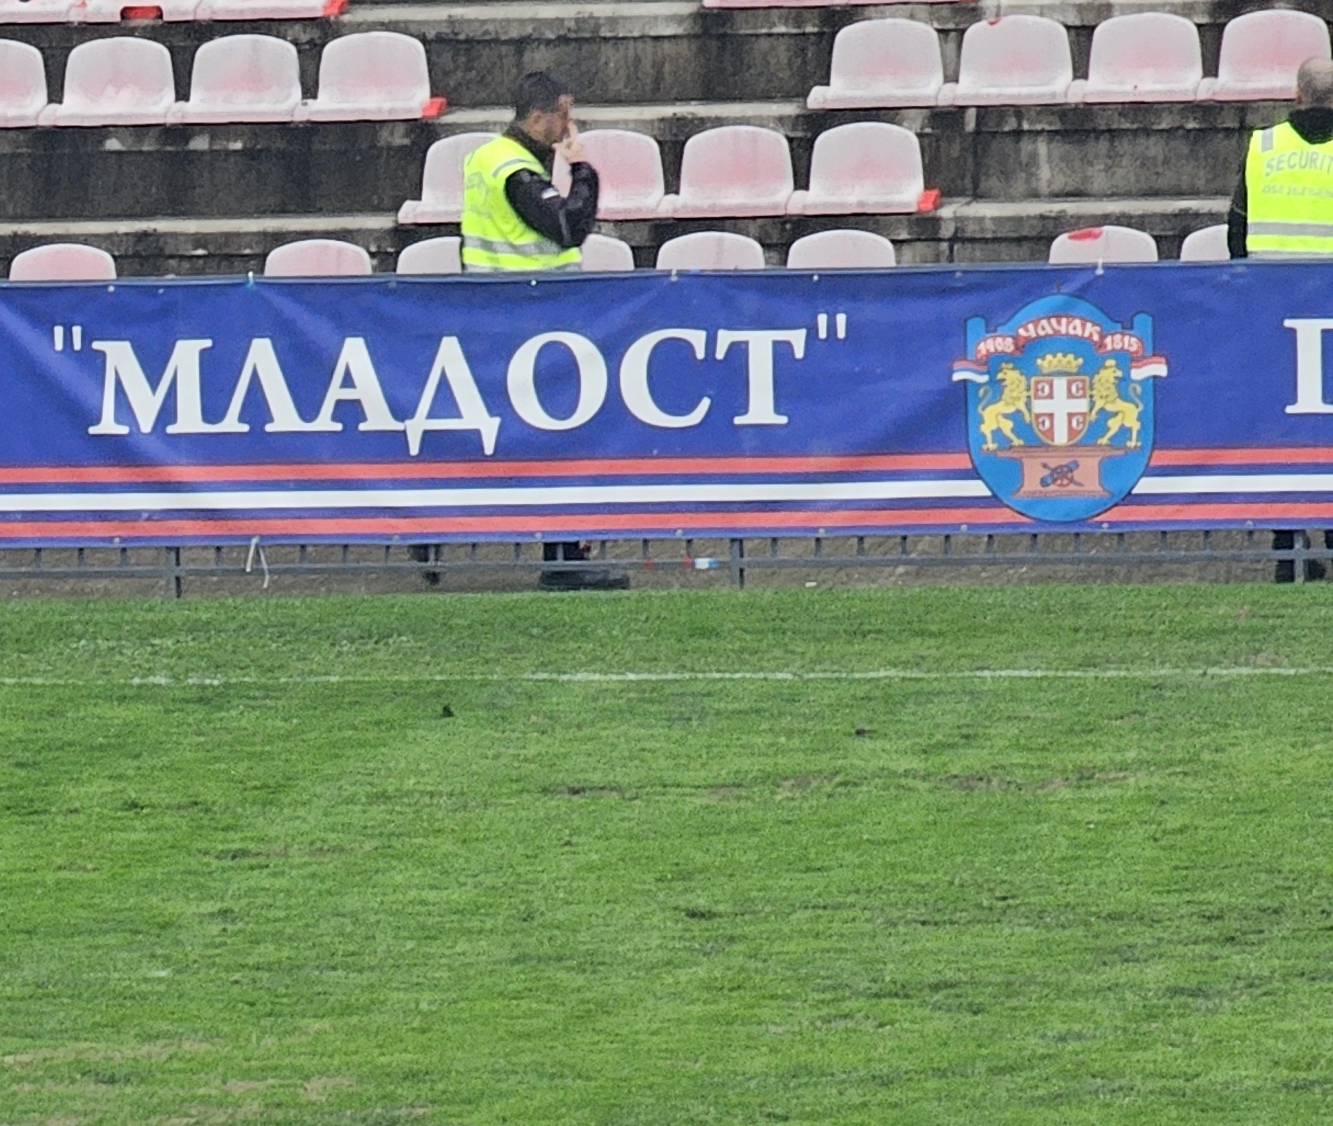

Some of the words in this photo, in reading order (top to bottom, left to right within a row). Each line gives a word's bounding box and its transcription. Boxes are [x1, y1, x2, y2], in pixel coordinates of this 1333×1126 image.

[1017, 317, 1101, 341] ЧАЧАК
[1103, 333, 1139, 352] 1815
[53, 313, 847, 457] "МЛАДОСТ"
